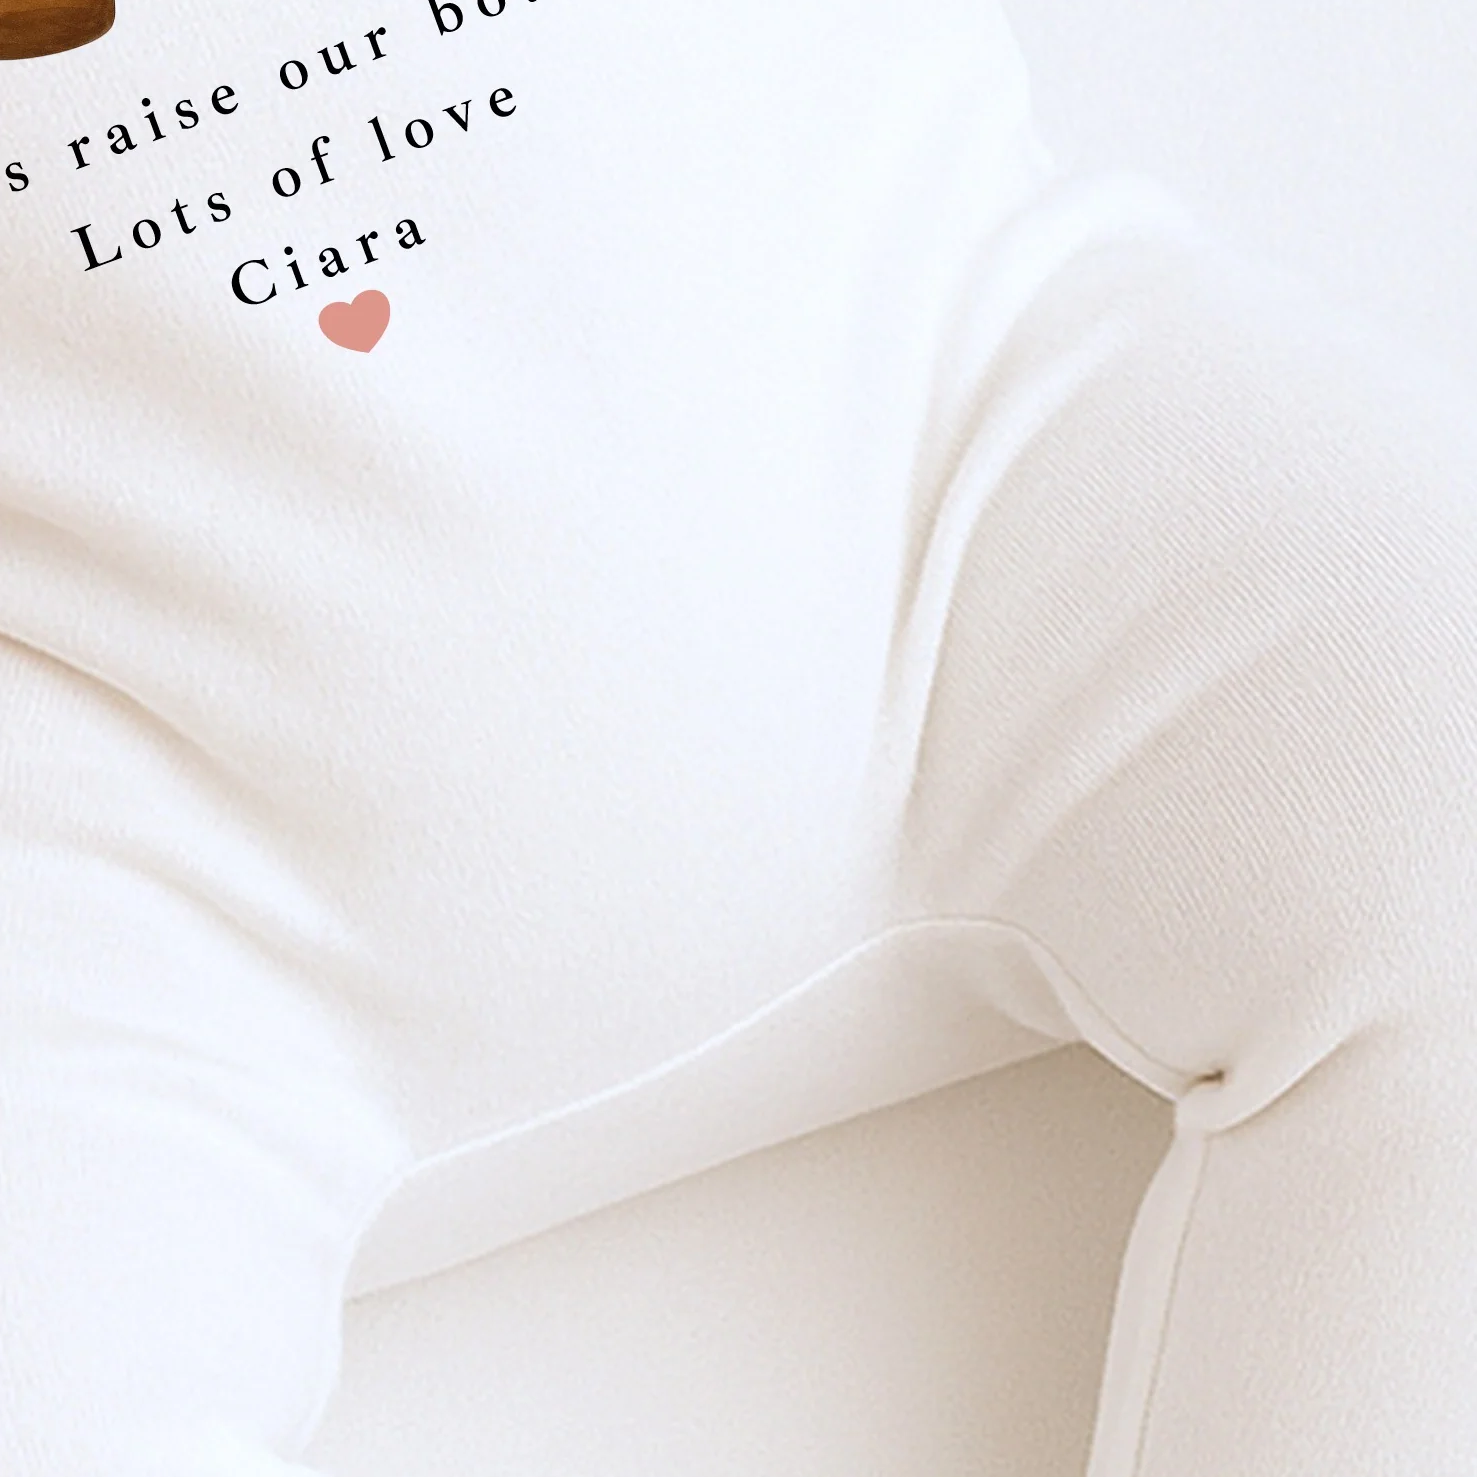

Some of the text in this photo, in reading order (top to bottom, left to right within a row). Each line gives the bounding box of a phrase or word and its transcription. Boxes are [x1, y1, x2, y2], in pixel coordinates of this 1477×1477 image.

[67, 85, 239, 170] raise
[279, 26, 387, 90] our
[69, 87, 517, 272] Lots of love
[231, 218, 427, 305] Ciara
